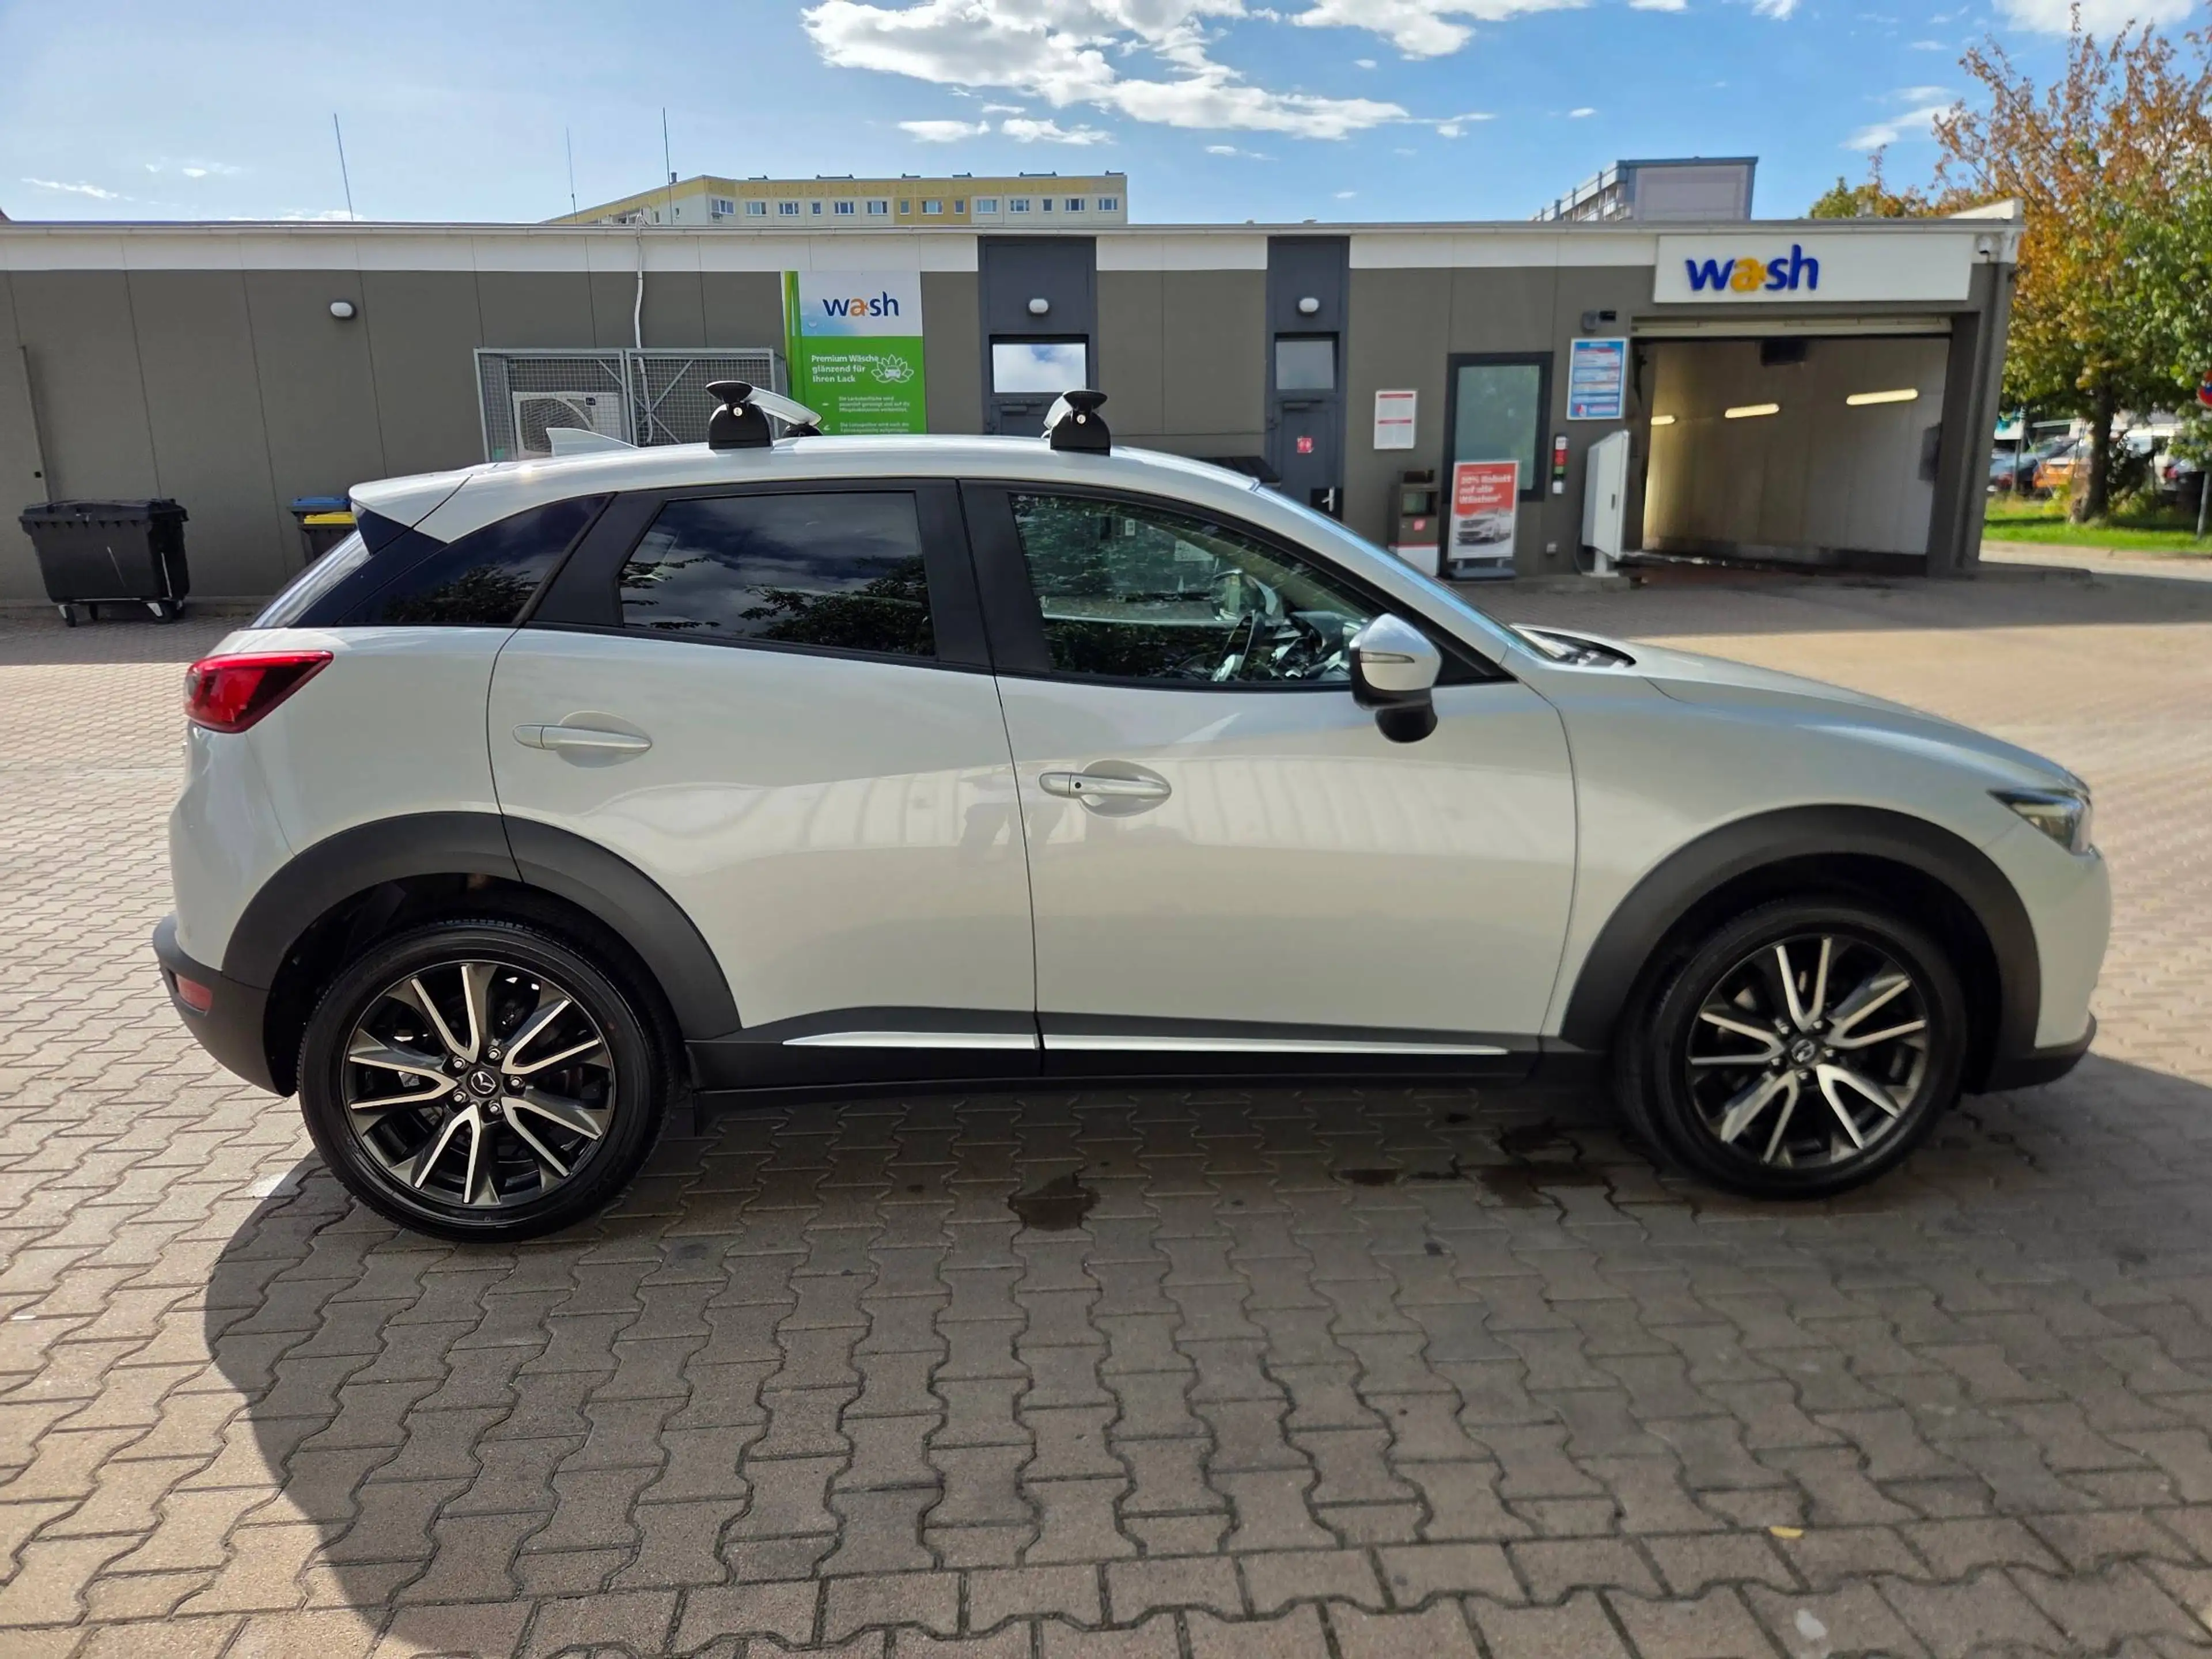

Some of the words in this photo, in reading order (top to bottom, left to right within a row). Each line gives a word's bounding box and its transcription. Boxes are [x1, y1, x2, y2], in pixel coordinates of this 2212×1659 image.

[1684, 244, 1820, 292] wash
[822, 291, 899, 316] wash
[849, 354, 879, 362] Wäsche
[812, 364, 851, 374] glänzend
[853, 364, 865, 372] für
[837, 374, 855, 382] Lack
